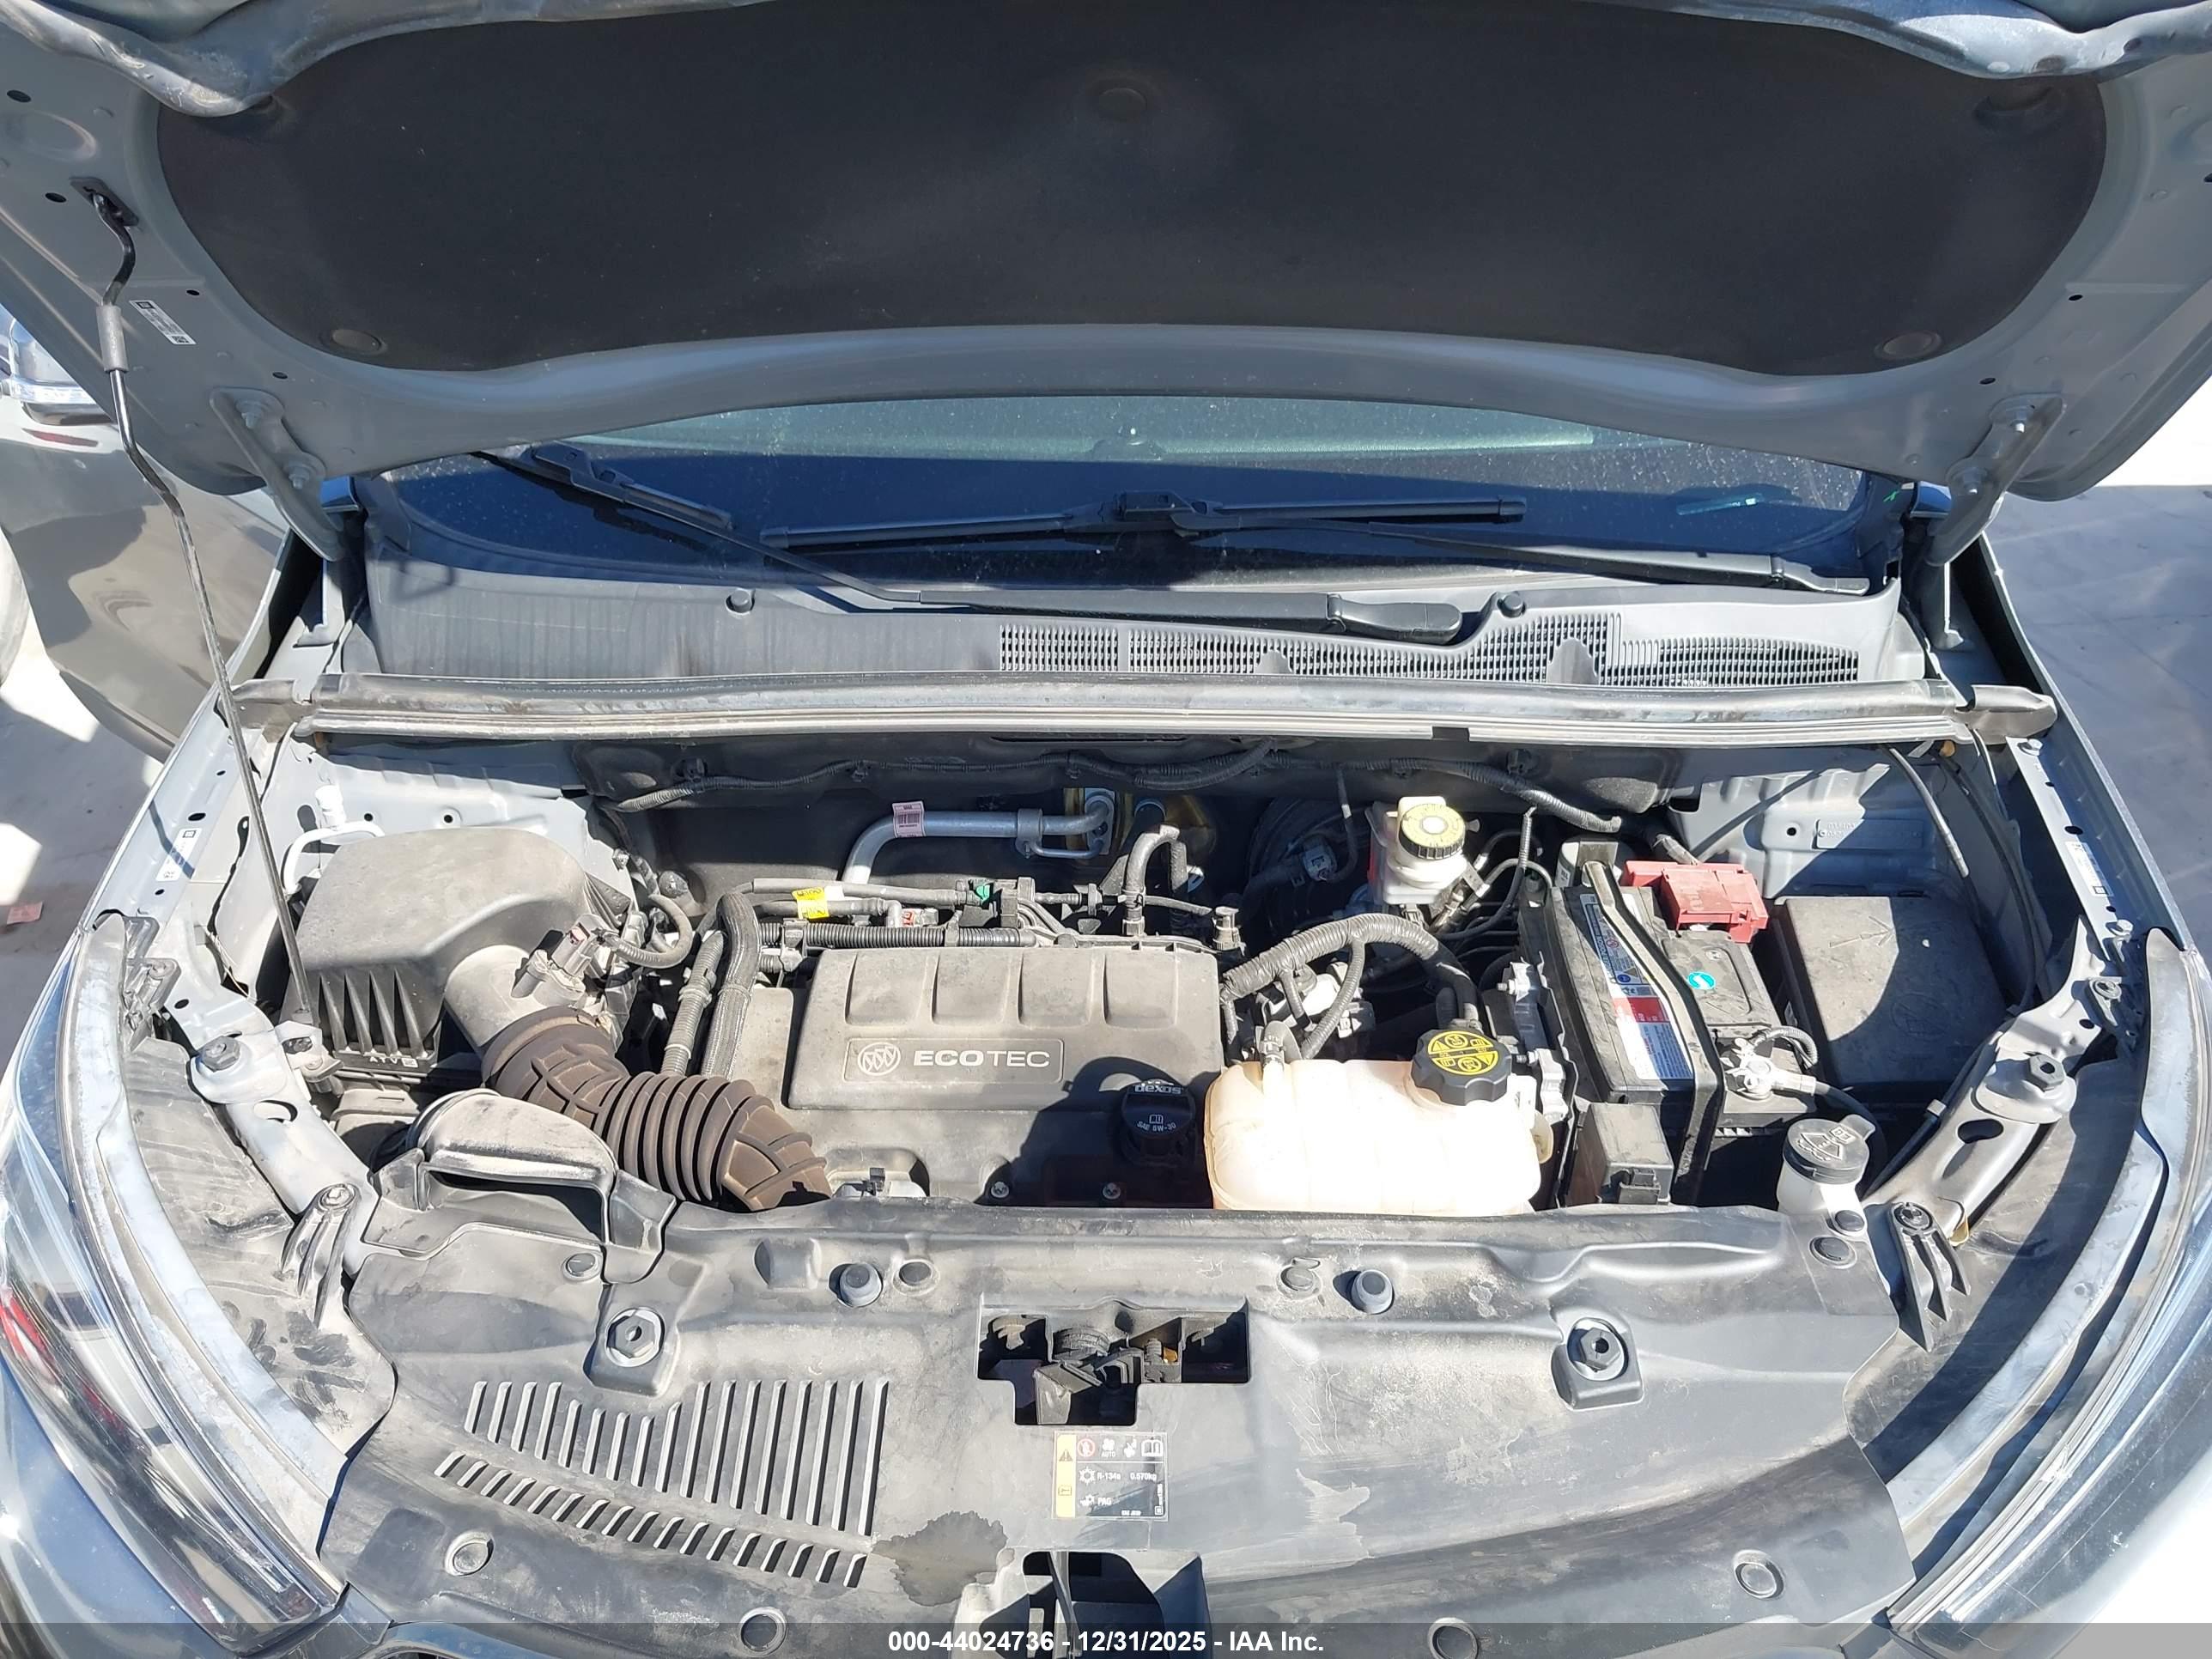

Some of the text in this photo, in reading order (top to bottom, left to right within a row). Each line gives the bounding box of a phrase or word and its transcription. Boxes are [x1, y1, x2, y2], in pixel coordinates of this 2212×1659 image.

[913, 1049, 1050, 1067] ECOTEC
[1134, 1084, 1182, 1094] dexos
[1137, 1121, 1176, 1132] SAE 5W-30
[1130, 1472, 1158, 1482] 0.570kg
